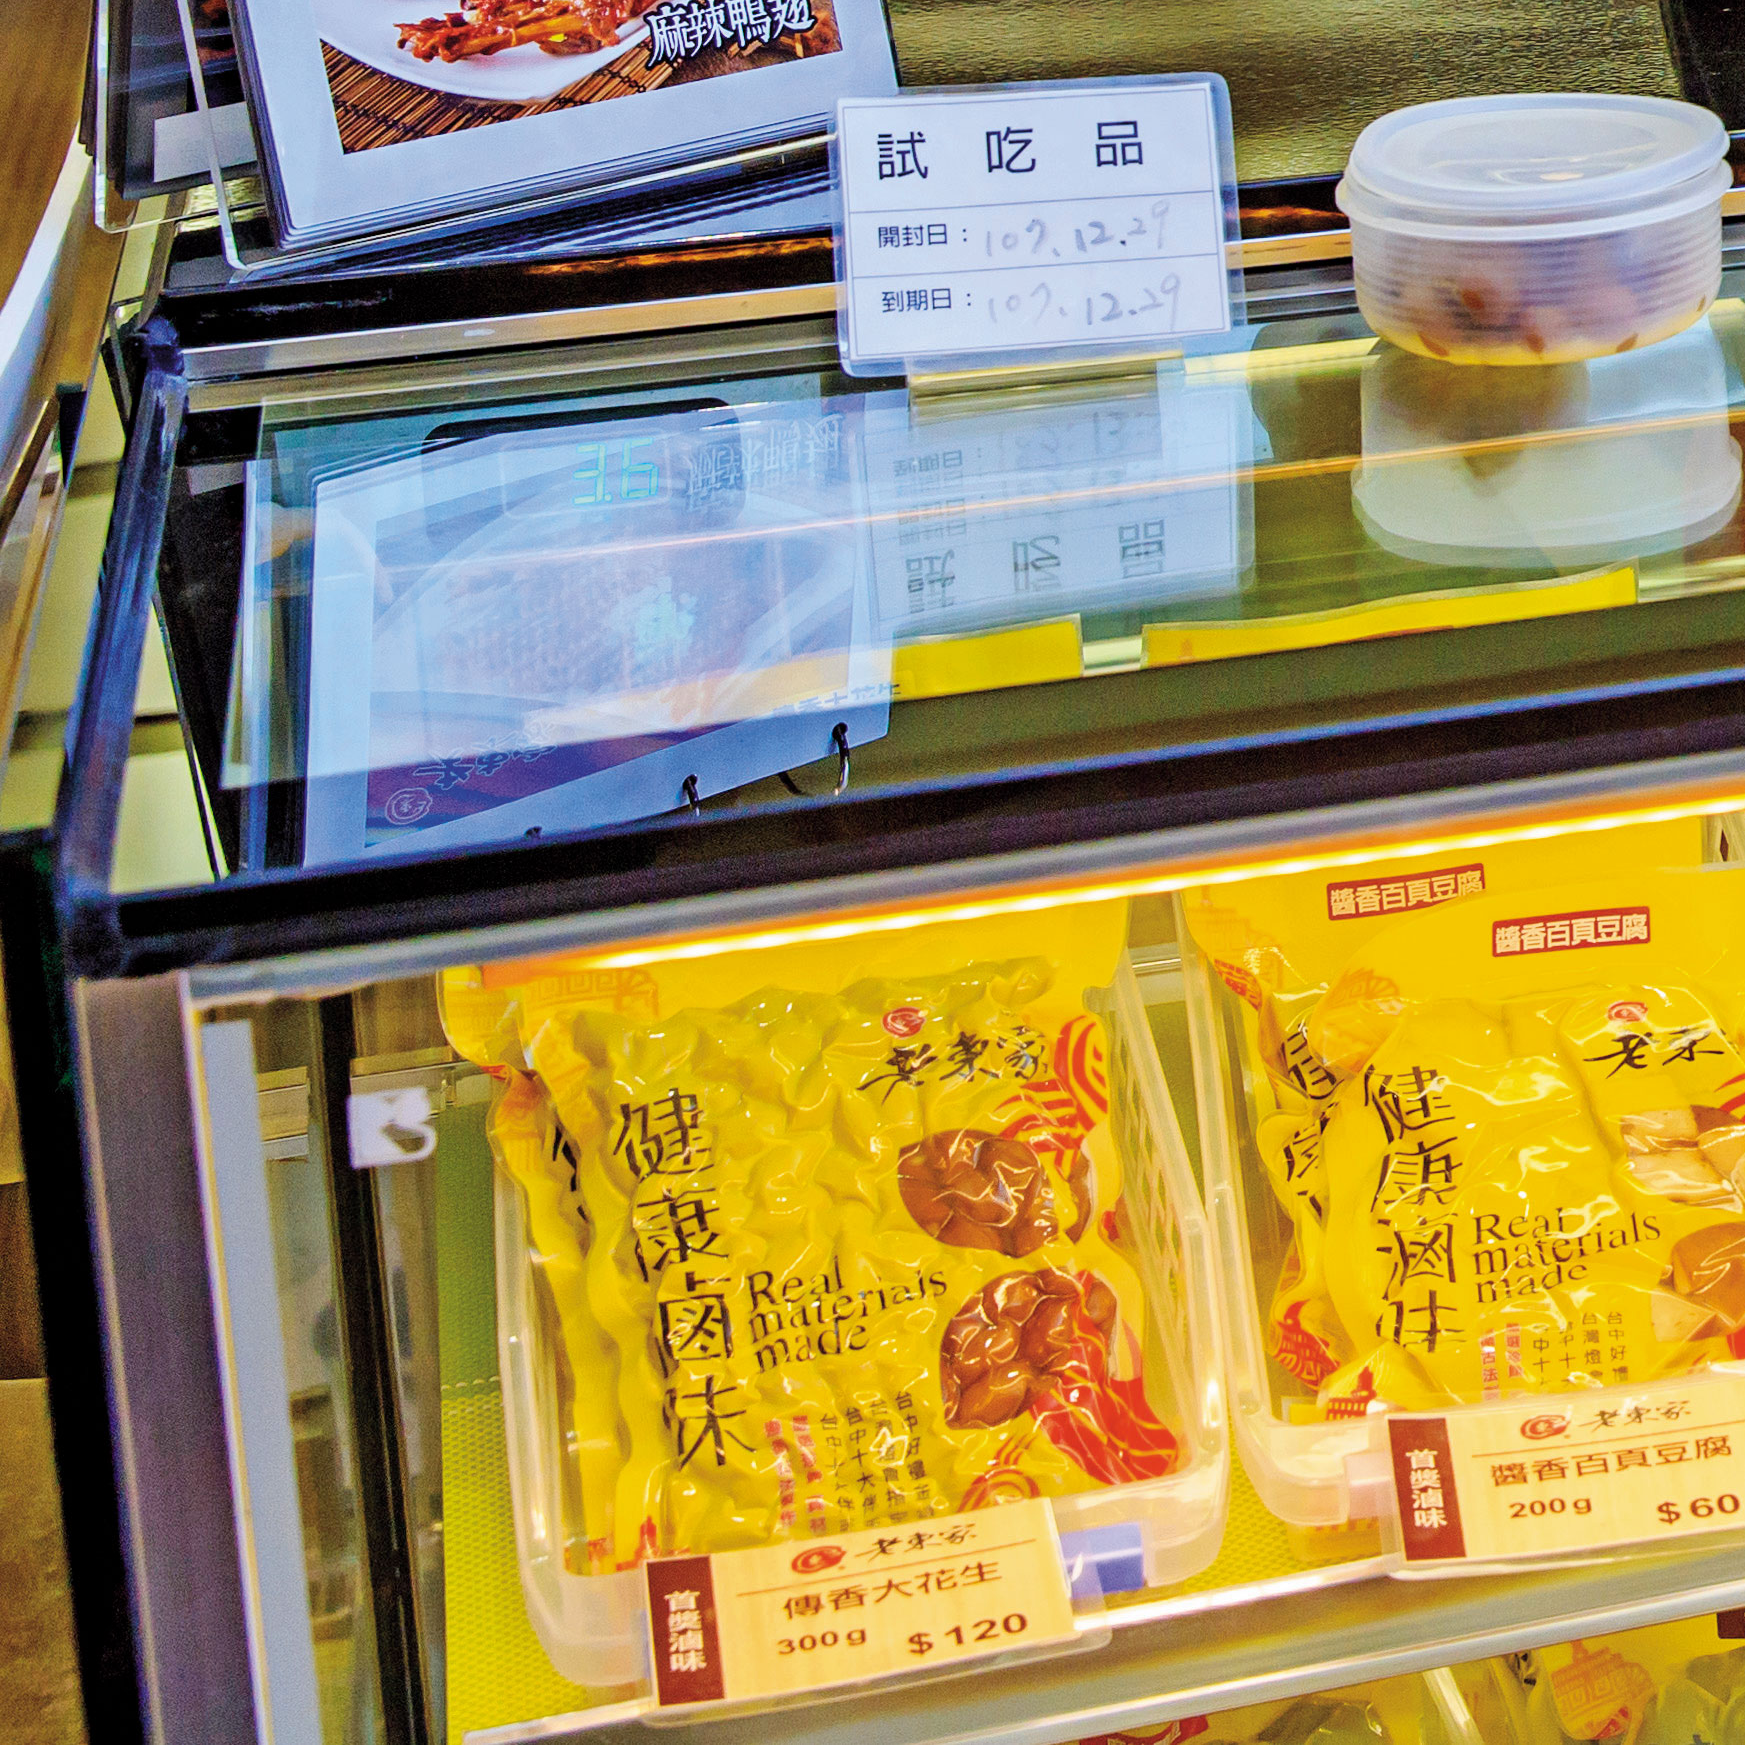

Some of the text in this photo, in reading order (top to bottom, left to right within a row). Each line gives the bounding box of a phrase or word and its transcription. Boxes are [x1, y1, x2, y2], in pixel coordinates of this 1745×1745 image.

[878, 120, 1143, 181] 試吃品
[1495, 912, 1648, 955] 醬香百頁豆腐
[1472, 1211, 1663, 1274] materials
[1475, 1264, 1588, 1303] made
[1656, 1494, 1741, 1524] $60
[783, 1561, 1003, 1620] 傳香大花生
